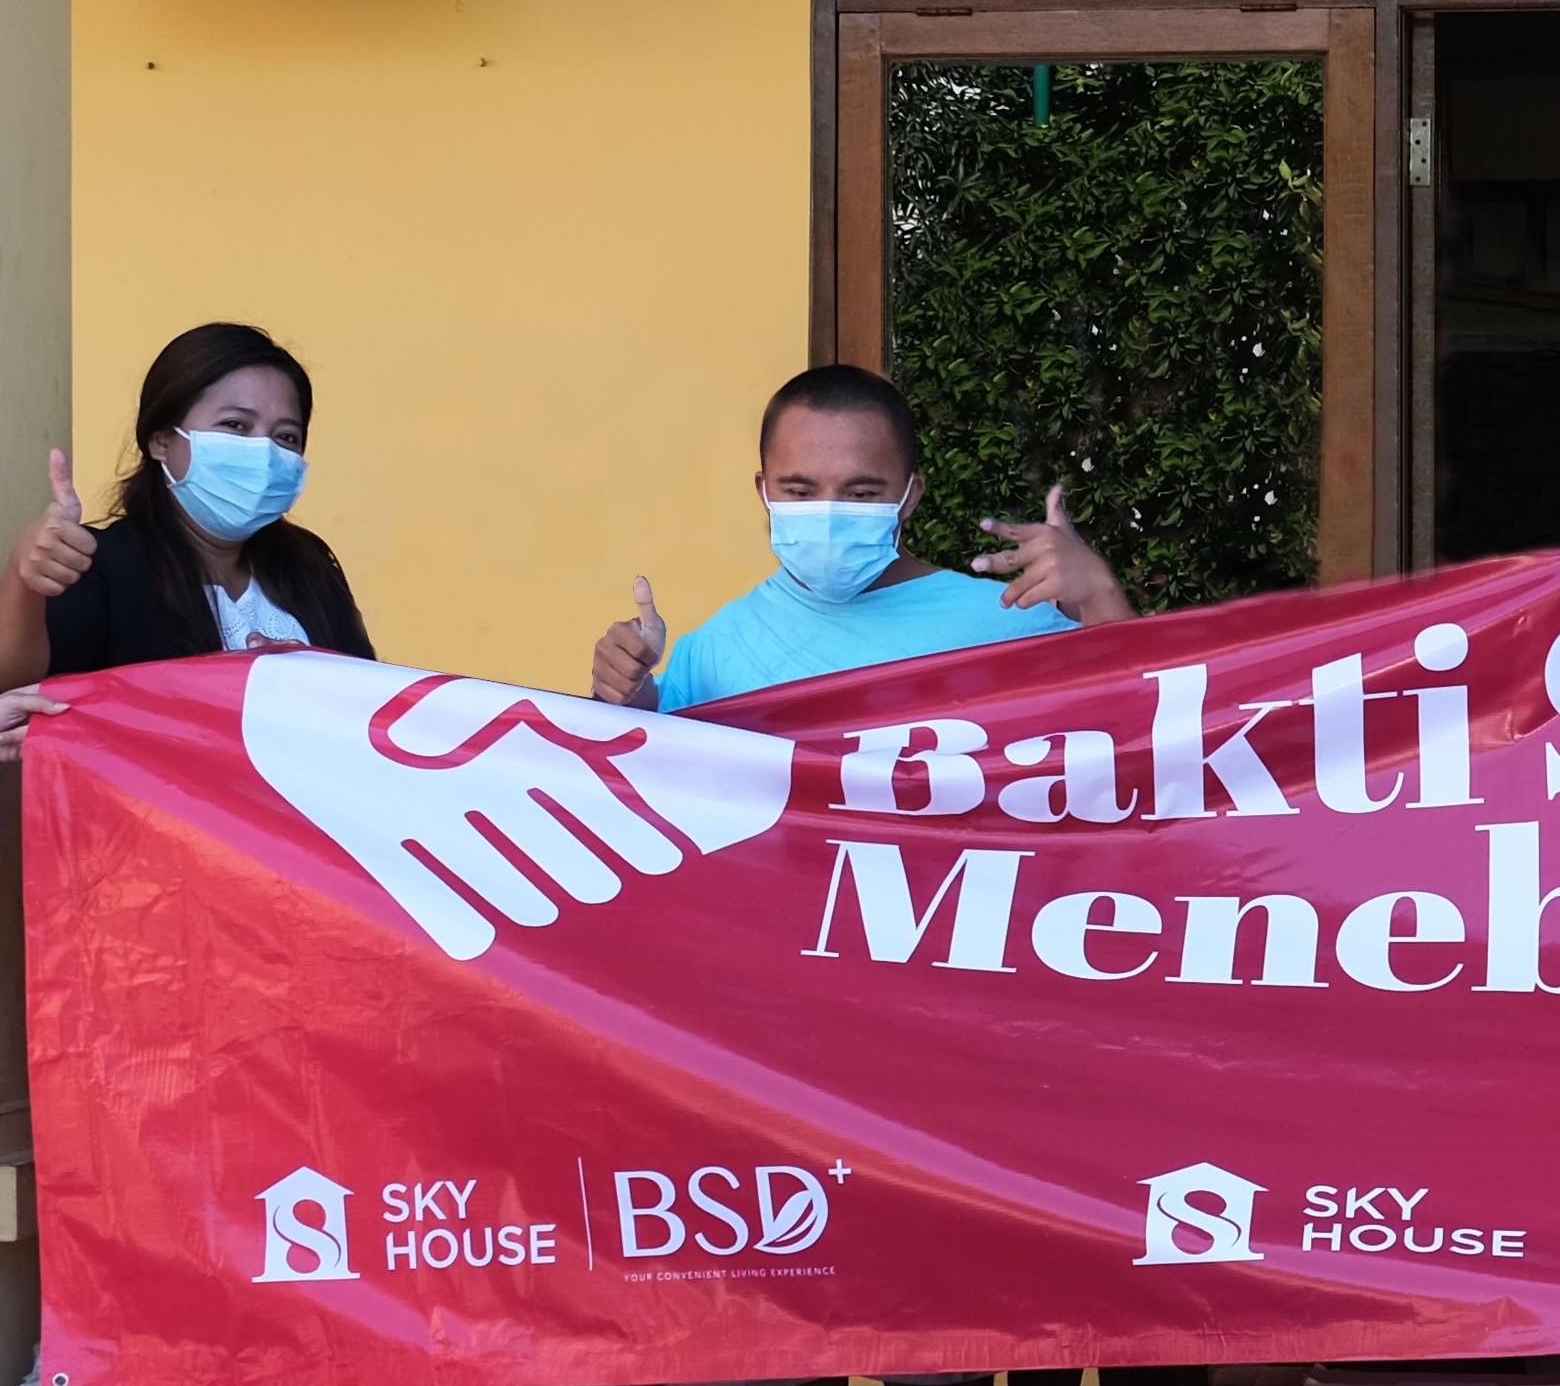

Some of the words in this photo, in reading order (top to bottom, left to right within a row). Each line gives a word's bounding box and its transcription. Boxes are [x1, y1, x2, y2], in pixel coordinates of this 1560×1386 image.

[829, 623, 1483, 824] Bakti
[382, 1179, 477, 1222] SKY
[1303, 1185, 1430, 1221] SKY
[386, 1223, 557, 1271] HOUSE
[1302, 1223, 1526, 1257] HOUSE
[624, 1273, 653, 1283] YOUR
[657, 1270, 726, 1282] CONVENIENT
[732, 1268, 766, 1279] LIVING
[770, 1266, 836, 1278] EXPERIENCE
